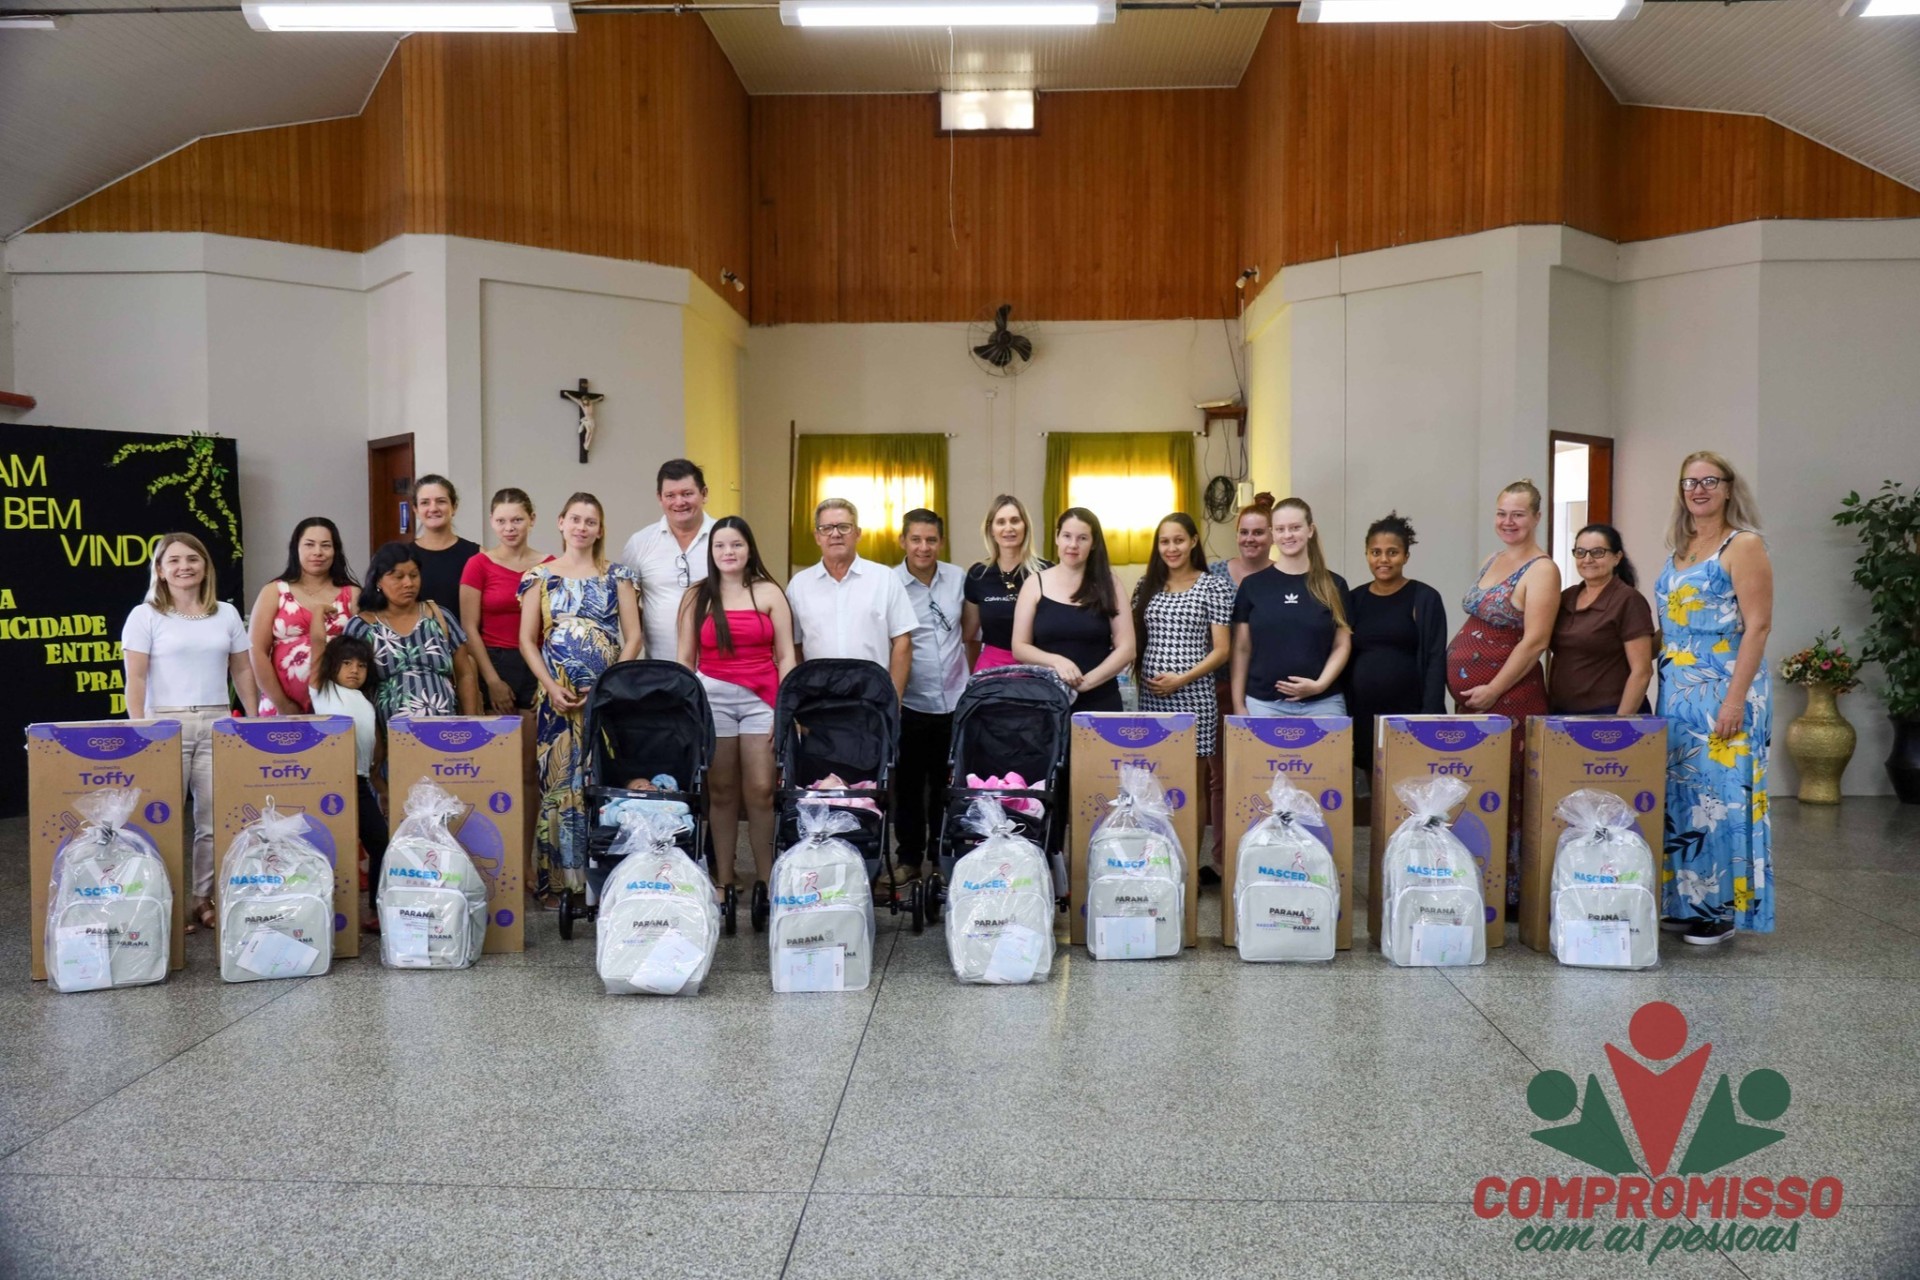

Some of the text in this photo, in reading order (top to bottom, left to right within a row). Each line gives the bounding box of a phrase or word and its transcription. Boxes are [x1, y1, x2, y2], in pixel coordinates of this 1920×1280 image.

[4, 497, 82, 530] BEM
[76, 670, 124, 693] PRA
[259, 765, 312, 780] Toffy
[431, 763, 481, 778] Toffy
[1110, 759, 1157, 773] Tffy
[1266, 759, 1313, 774] Toffy
[1427, 762, 1473, 777] Toffy
[1583, 762, 1629, 777] Toffy
[79, 771, 135, 787] Toffy
[229, 875, 281, 885] NASCER
[389, 868, 439, 880] NASCER
[1258, 865, 1307, 881] NASCER
